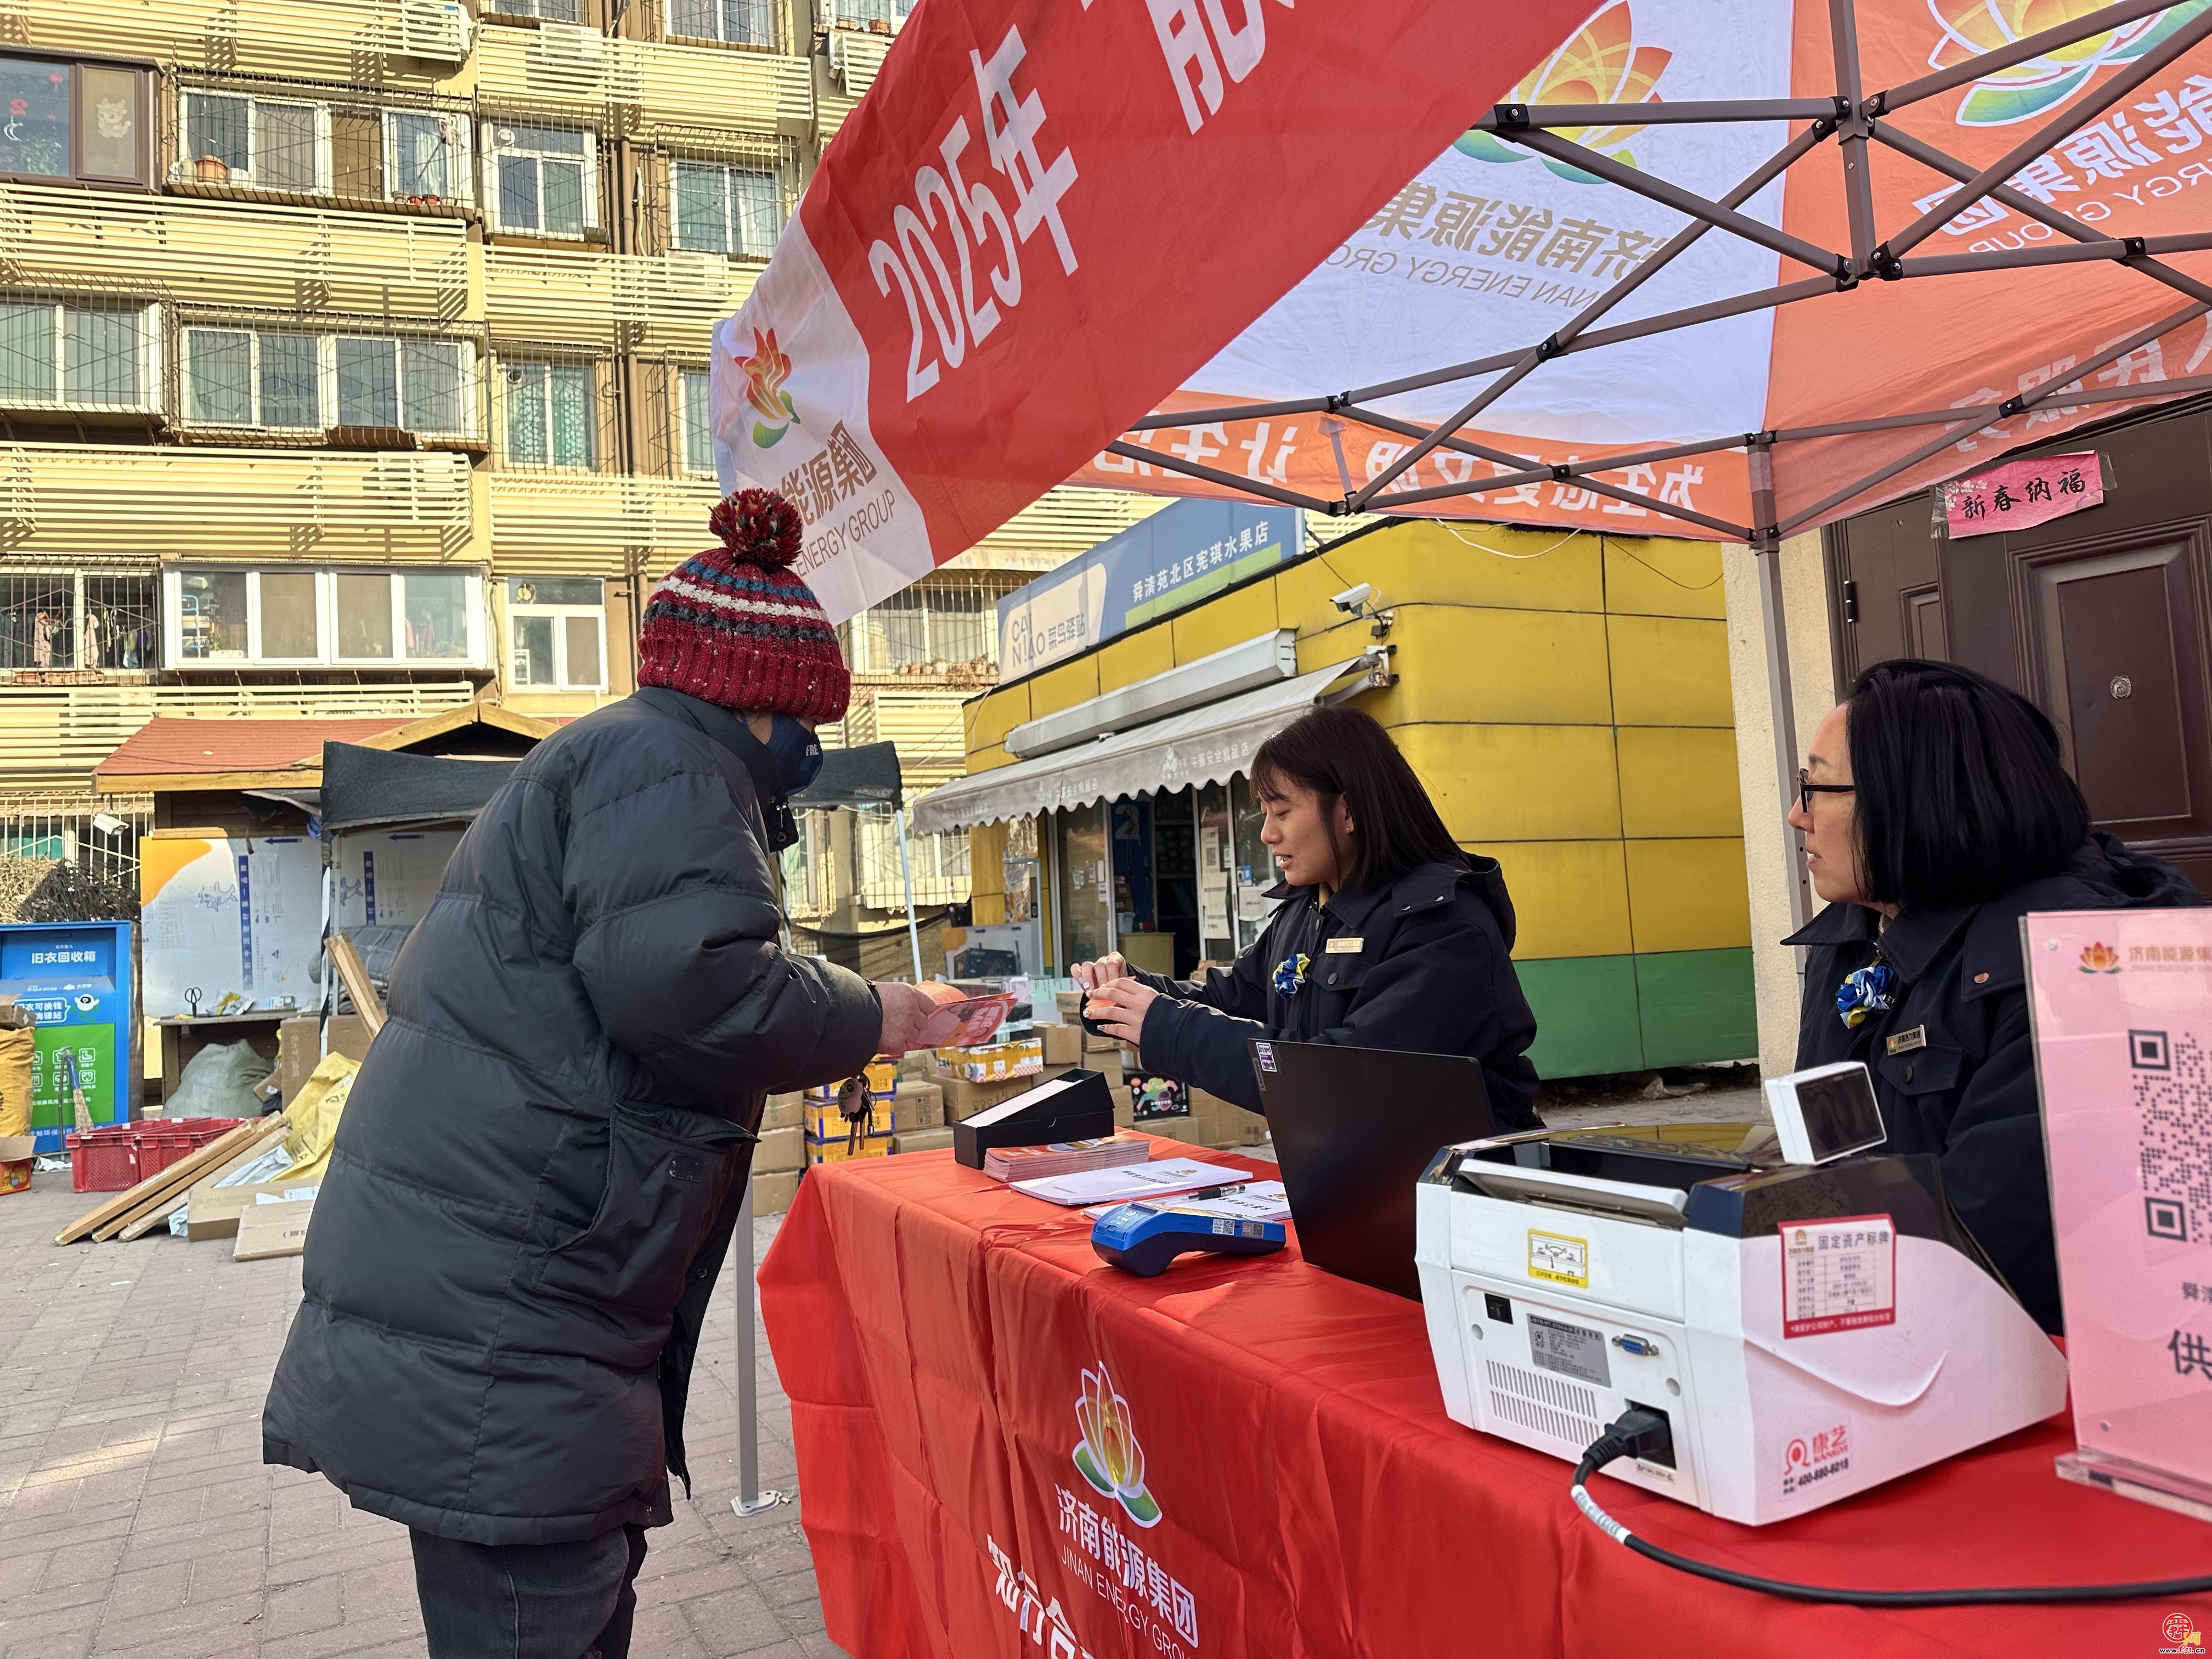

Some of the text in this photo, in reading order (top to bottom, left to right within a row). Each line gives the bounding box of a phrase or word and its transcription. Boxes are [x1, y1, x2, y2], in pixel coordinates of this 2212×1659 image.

[868, 24, 1079, 403] 2025年
[780, 420, 877, 527] 能源集团
[1961, 468, 2085, 521] 新春纳福
[796, 488, 896, 578] ENERGY GROUP
[1133, 521, 1269, 603] 舜清苑北区宪琪水果店
[1048, 612, 1086, 652] 菜鸟驿站
[31, 950, 96, 964] 旧衣回收箱
[36, 1012, 62, 1020] 询驿站
[1819, 1231, 1889, 1250] 固定资产标牌
[1812, 1425, 1846, 1454] 康艺
[987, 1533, 1096, 1659] 知行合
[1054, 1483, 1199, 1649] 济南能源集团
[1062, 1544, 1094, 1589] JINAN
[1097, 1571, 1149, 1638] ENERGY
